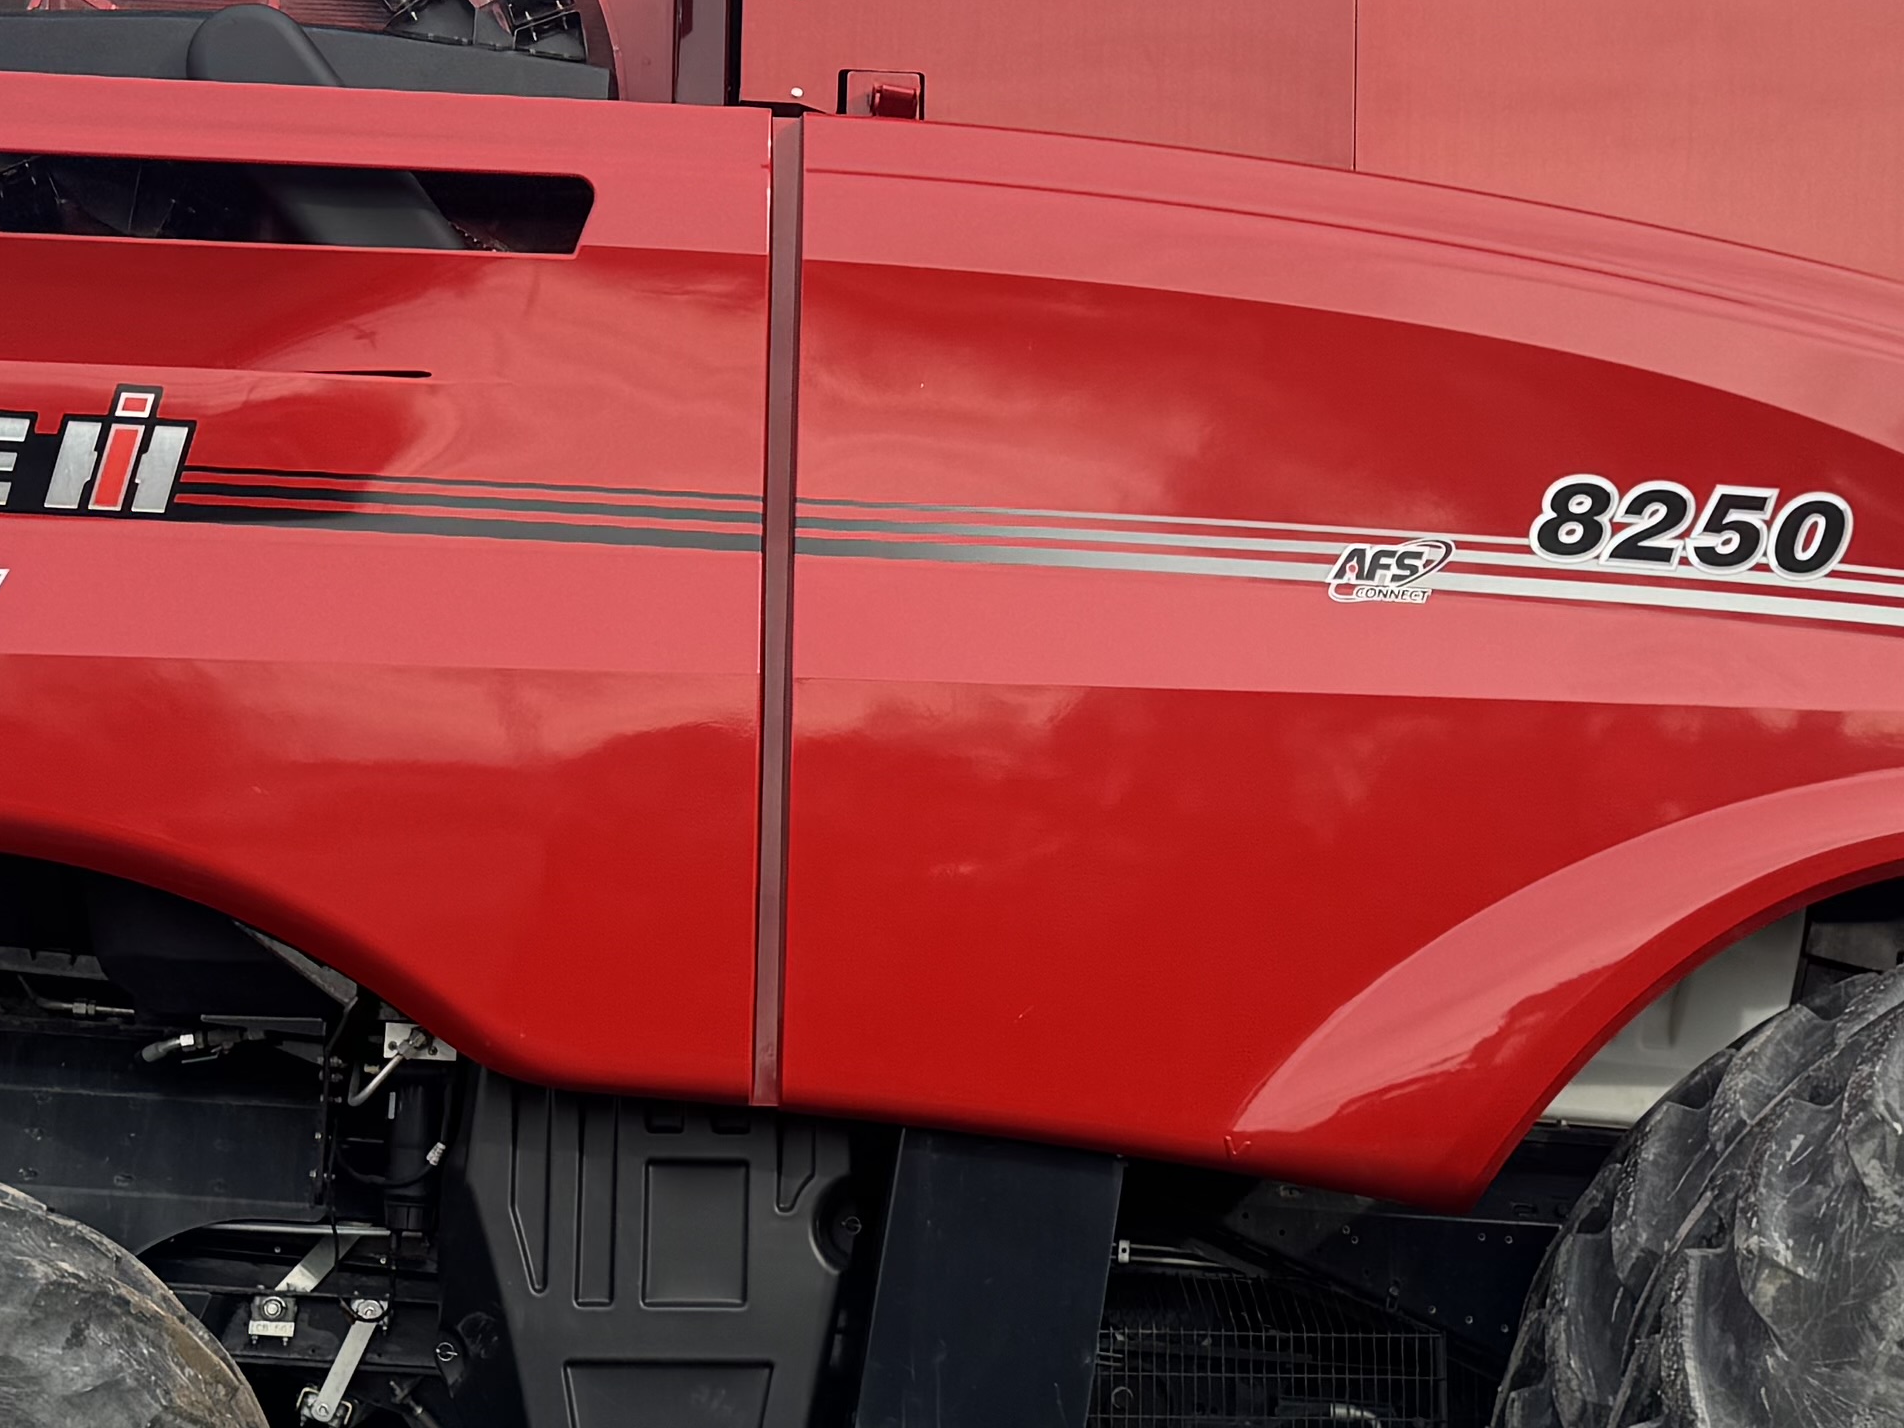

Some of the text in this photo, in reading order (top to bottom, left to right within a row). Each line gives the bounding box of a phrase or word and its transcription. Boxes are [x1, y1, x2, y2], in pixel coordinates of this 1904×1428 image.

[1529, 473, 1854, 582] 8250
[1330, 545, 1428, 584] AFS
[1355, 586, 1430, 604] CONNECT
